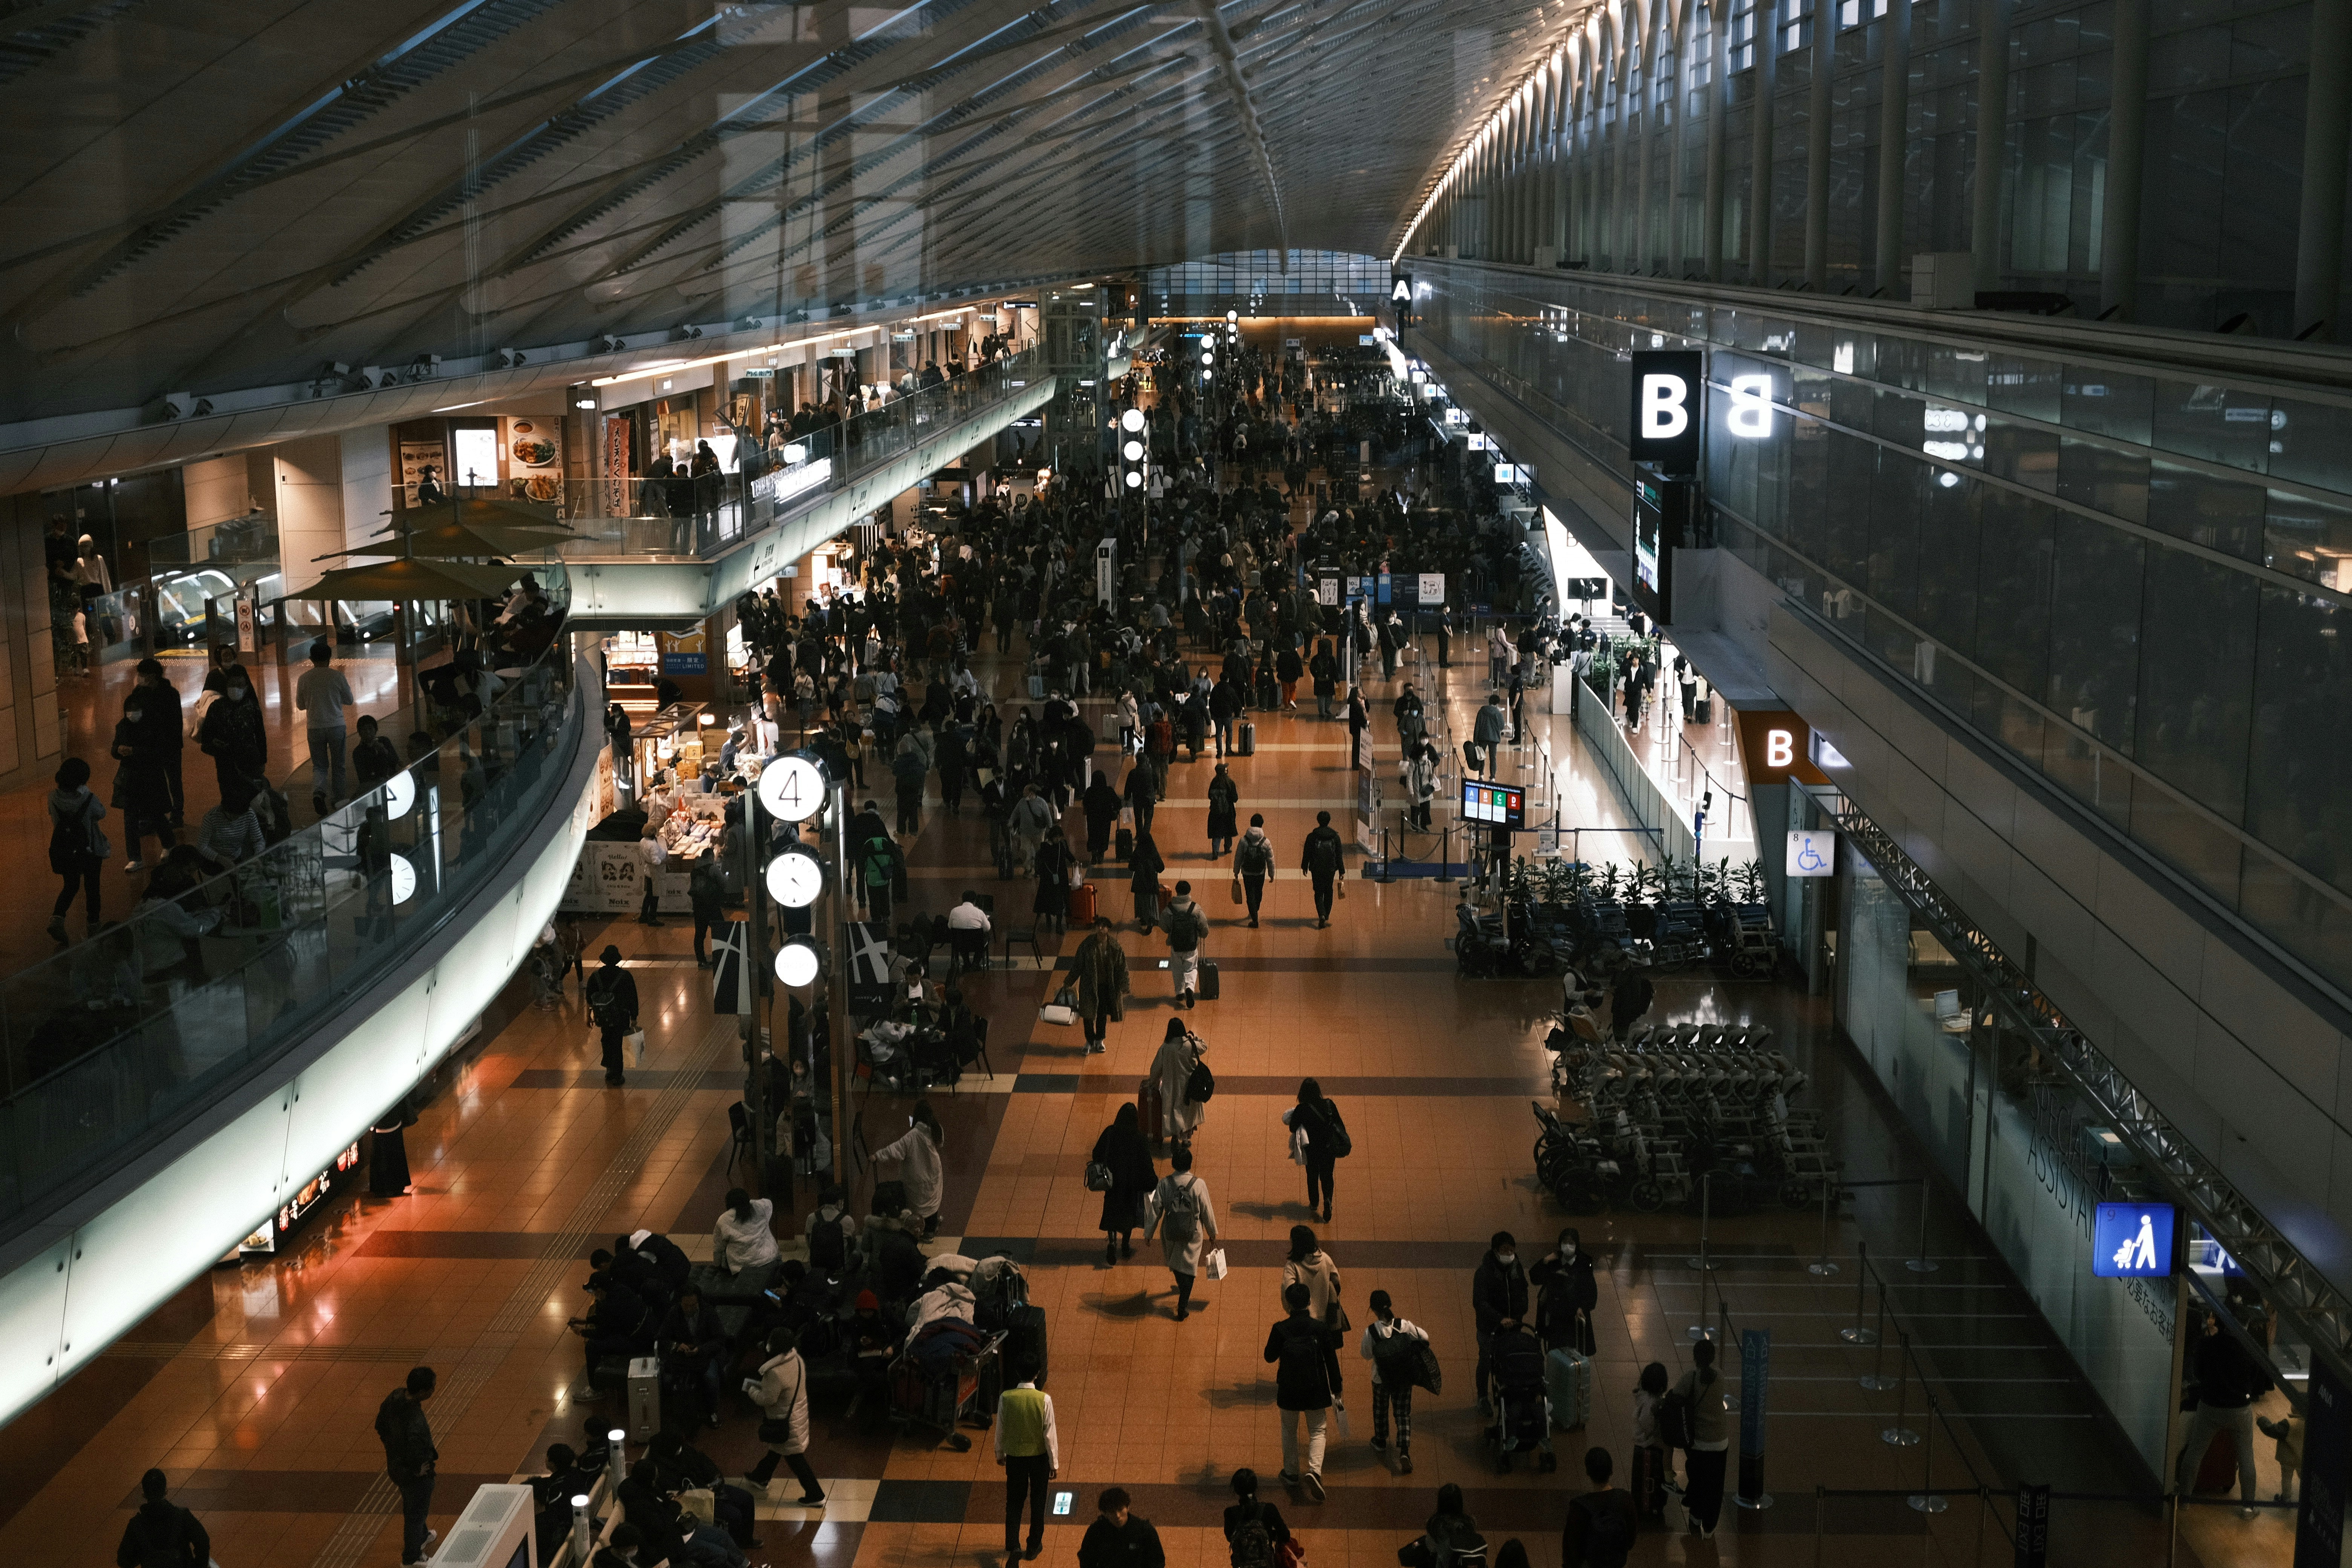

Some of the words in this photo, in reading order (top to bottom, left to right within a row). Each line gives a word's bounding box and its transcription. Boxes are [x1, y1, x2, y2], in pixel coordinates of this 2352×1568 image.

[1392, 280, 1411, 300] A
[1410, 359, 1419, 370] A
[1642, 374, 1688, 438] B
[1768, 729, 1793, 767] B
[778, 770, 802, 807] 4
[1793, 833, 1799, 842] 8
[2031, 1075, 2092, 1187] SPECIAL
[2027, 1126, 2096, 1242] ASSISTAN
[2107, 1208, 2115, 1220] 9
[1746, 1337, 1755, 1359] 入口
[1761, 1337, 1768, 1358] 入口
[2318, 1384, 2333, 1408] ANA
[2020, 1490, 2030, 1517] 出口
[2036, 1493, 2046, 1519] 出口
[2018, 1521, 2029, 1554] EXIT
[2033, 1525, 2045, 1553] EXIT
